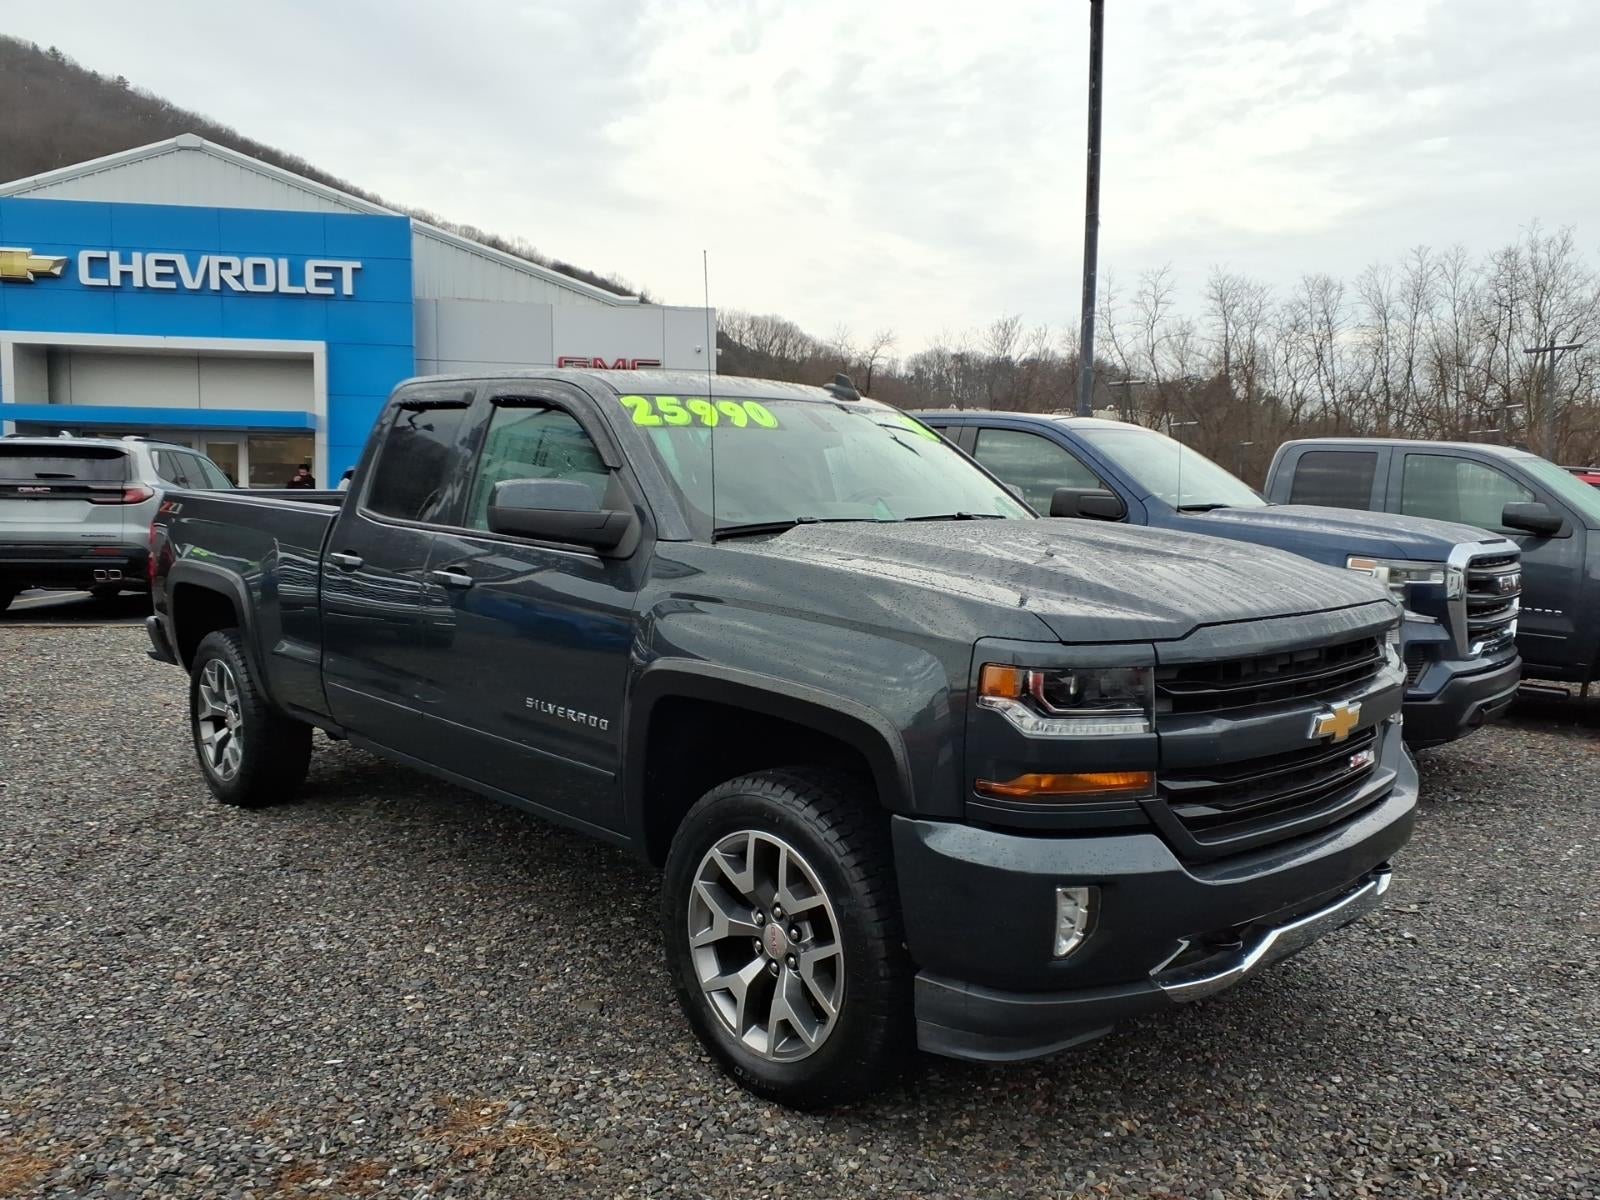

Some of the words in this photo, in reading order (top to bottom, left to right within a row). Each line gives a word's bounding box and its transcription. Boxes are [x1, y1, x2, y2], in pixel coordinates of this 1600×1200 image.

[78, 250, 362, 296] CHEVROLET
[620, 395, 778, 428] 25990
[17, 486, 52, 494] GMC
[525, 697, 609, 731] SILVERADO
